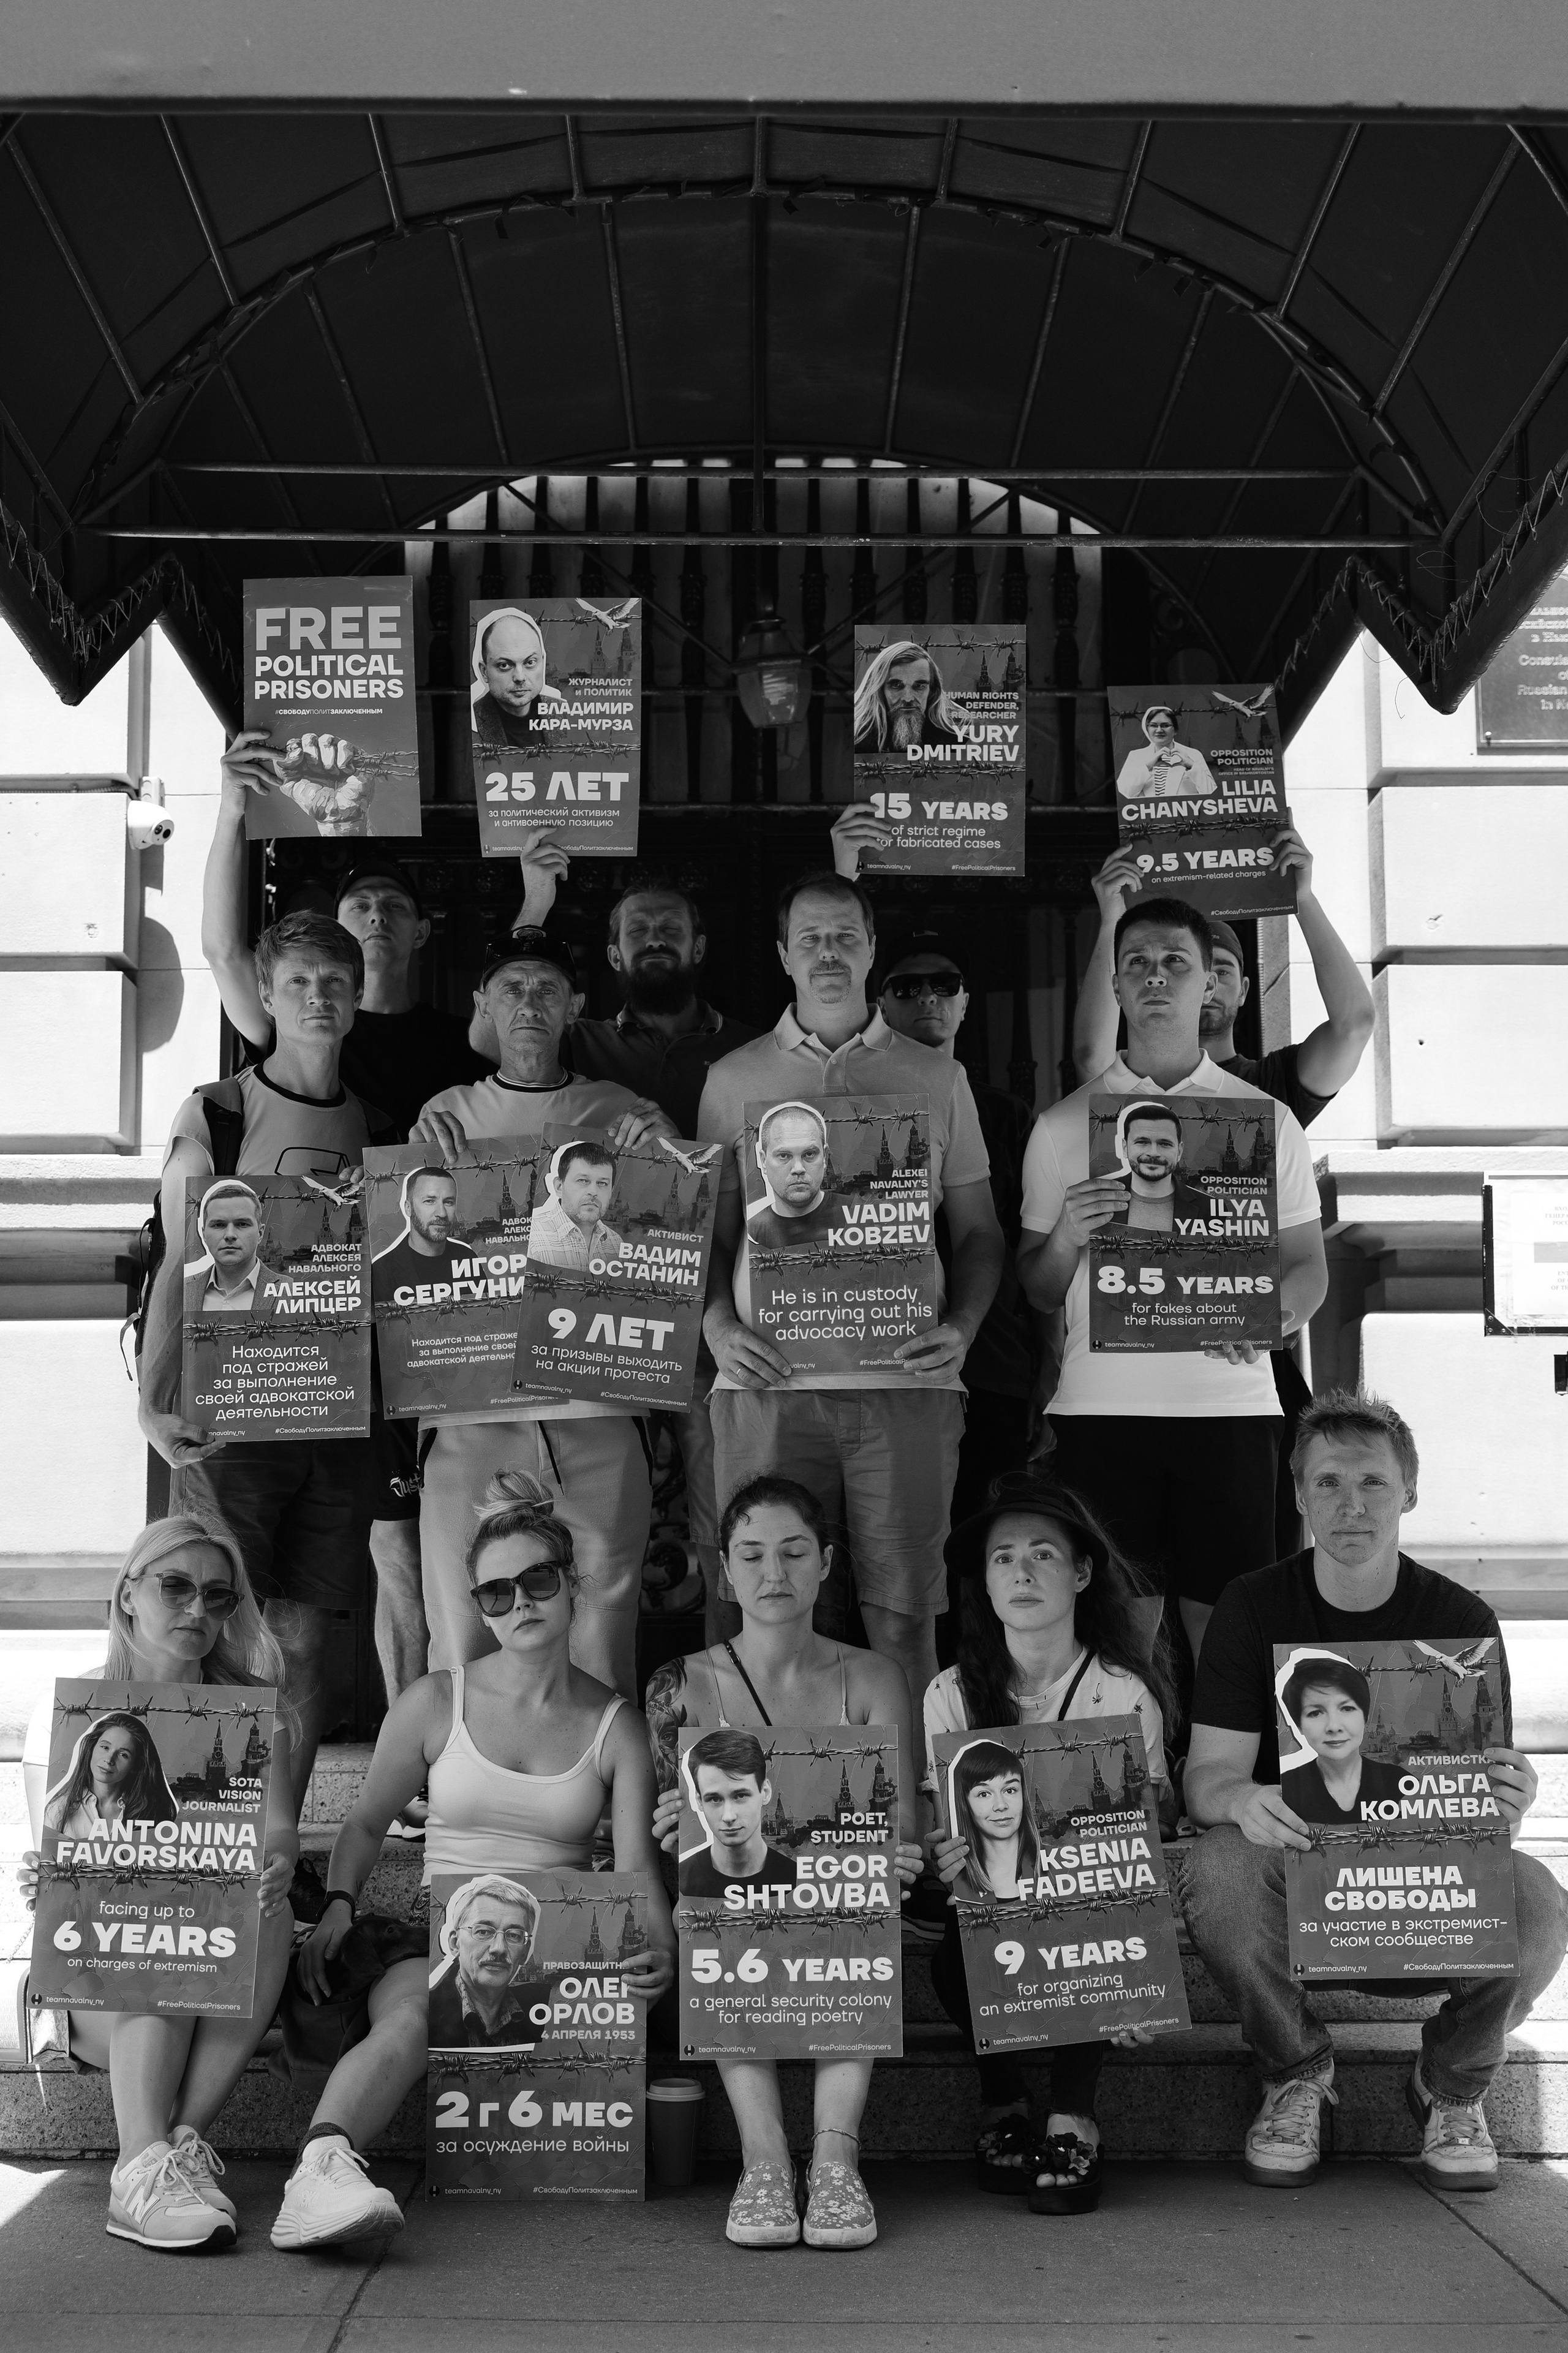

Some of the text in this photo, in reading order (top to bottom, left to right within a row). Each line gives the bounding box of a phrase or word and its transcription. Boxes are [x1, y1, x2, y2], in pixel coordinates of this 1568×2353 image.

[256, 606, 401, 651] FREE
[256, 655, 403, 676] POLITICAL
[255, 679, 403, 699] PRISONERS
[538, 703, 633, 716] ВЛАДИМИР
[529, 719, 633, 730] КАРА-МУРЗА
[952, 725, 1019, 742] YURY
[907, 745, 1019, 761] DMITRIEV
[1218, 757, 1273, 766] POLITICIAN
[485, 772, 628, 801] 25 ЛЕТ
[1222, 780, 1276, 796] LILIA
[501, 808, 568, 817] политический
[870, 793, 1008, 820] 15 YEARS
[1122, 798, 1278, 820] CHANYSHEVA
[908, 825, 986, 838] strict regime
[897, 837, 961, 847] fabricated
[1137, 847, 1274, 873] 9.5 YEARS
[1163, 872, 1233, 882] extremism-related
[892, 1169, 927, 1177] ALEXEI
[1201, 1176, 1267, 1185] OPPOSITION
[870, 1179, 928, 1188] NAVALNY'S
[886, 1190, 928, 1199] LAWYER
[842, 1202, 929, 1223] VADIM
[1210, 1199, 1266, 1217] ILYA
[647, 1229, 704, 1242] АКТИВИСТ
[828, 1225, 930, 1246] KOBZEV
[1175, 1218, 1268, 1236] YASHIN
[619, 1242, 701, 1267] ВАДИМ
[288, 1264, 361, 1273] НАВАЛЬНОГО
[451, 1254, 527, 1278] ИГОР
[589, 1258, 699, 1286] ОСТАНИН
[263, 1276, 360, 1297] АЛЕКСЕЙ
[1098, 1266, 1273, 1294] 8.5 YEARS
[394, 1276, 525, 1305] СЕРГУНИ
[844, 1285, 918, 1303] custody
[276, 1297, 361, 1313] ЛИПЦЕР
[759, 1302, 932, 1324] for carrying out his
[1197, 1303, 1237, 1313] about
[548, 1309, 674, 1350] 9 ЛЕТ
[1152, 1315, 1245, 1326] Russian army
[776, 1321, 916, 1340] advocacy work
[412, 1335, 461, 1347] Находится
[432, 1344, 489, 1355] выполнение
[257, 1359, 328, 1375] стражей
[407, 1357, 466, 1367] адвокатской
[552, 1346, 682, 1372] призывы выходить
[238, 1375, 337, 1388] выполнение
[558, 1362, 669, 1383] акции протеста
[195, 1386, 354, 1405] своей адвокатской
[216, 1405, 328, 1421] деятельности
[229, 1777, 262, 1788] SOTA
[1398, 1773, 1491, 1796] ОЛЬГА
[219, 1790, 261, 1800] VISION
[182, 1801, 260, 1813] JOURNALIST
[1361, 1797, 1499, 1821] КОМЛЕВА
[841, 1811, 888, 1826] POET,
[1071, 1810, 1145, 1826] OPPOSITION
[88, 1819, 257, 1846] ANTONINA
[811, 1830, 888, 1843] STUDENT
[1080, 1822, 1147, 1838] POLITICIAN
[57, 1841, 255, 1871] FAVORSKAYA
[1041, 1838, 1151, 1871] KSENIA
[797, 1855, 888, 1879] EGOR
[1017, 1864, 1156, 1901] FADEEVA
[1336, 1866, 1463, 1887] ЛИШЕНА
[724, 1883, 890, 1911] SHTOVBA
[1325, 1889, 1477, 1911] СВОБОДЫ
[100, 1901, 148, 1919] facing
[1322, 1917, 1507, 1935] участие экстремист-
[53, 1921, 236, 1957] 6 YEARS
[1330, 1933, 1473, 1947] ском сообществе
[995, 1937, 1147, 1974] 9 YEARS
[86, 1958, 217, 1973] charges extremism
[543, 1960, 636, 1970] ПРАВОЗАЩИТН
[692, 1949, 894, 1983] 5.6 YEARS
[1404, 1962, 1513, 1971] #СвободуПолитзаключенным
[1044, 1973, 1123, 1995] organizing
[47, 1996, 240, 2010] teamnavalny_ny #FreePoliticalPrisoners
[705, 1993, 891, 2011] general security colony
[1005, 1984, 1165, 2013] extremist community
[529, 2003, 635, 2025] ОРЛОВ
[746, 2010, 862, 2025] reading poetry
[552, 2030, 635, 2039] АПРЕЛЯ 1953
[1099, 2019, 1178, 2033] #FreePoliticalPrisoners
[436, 2091, 633, 2128] 2 6 МЕС
[464, 2136, 629, 2155] осуждение войны
[533, 2186, 637, 2194] #СвободуПолитзаключенным
